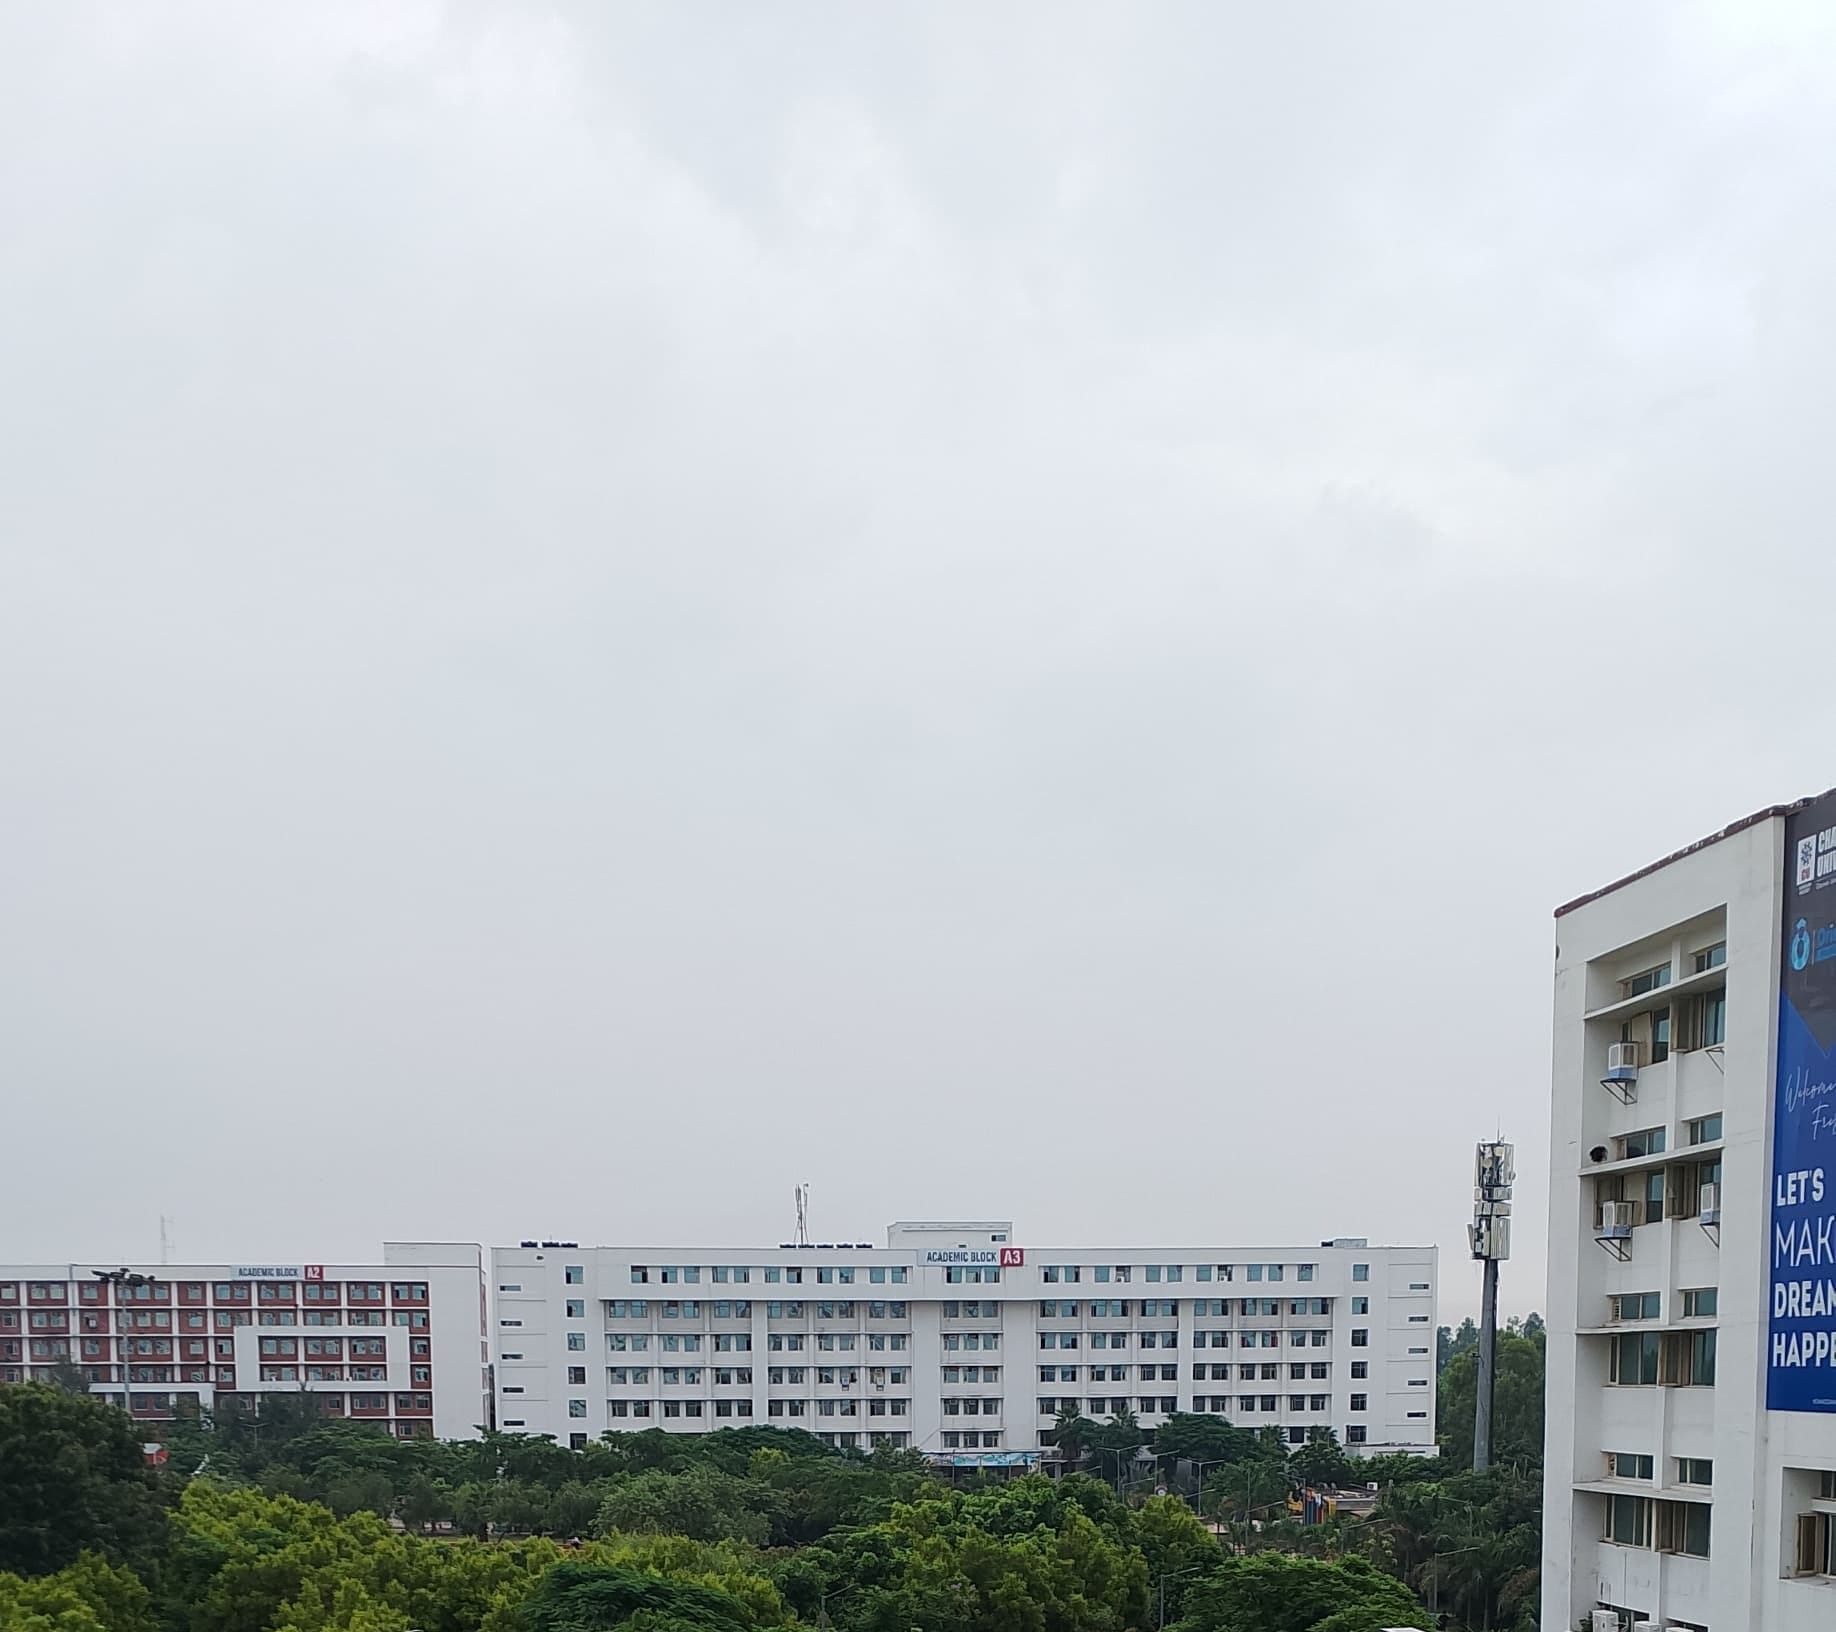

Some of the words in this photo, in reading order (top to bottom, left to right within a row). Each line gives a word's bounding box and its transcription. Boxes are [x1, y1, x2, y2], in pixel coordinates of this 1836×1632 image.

[1776, 1167, 1825, 1207] LET'S
[926, 1251, 969, 1263] ACADEMIC
[970, 1251, 997, 1263] BLOCK
[1003, 1250, 1021, 1265] A3
[238, 1267, 275, 1277] ACADEMIC
[276, 1267, 299, 1277] BLOCK
[307, 1266, 321, 1279] A2
